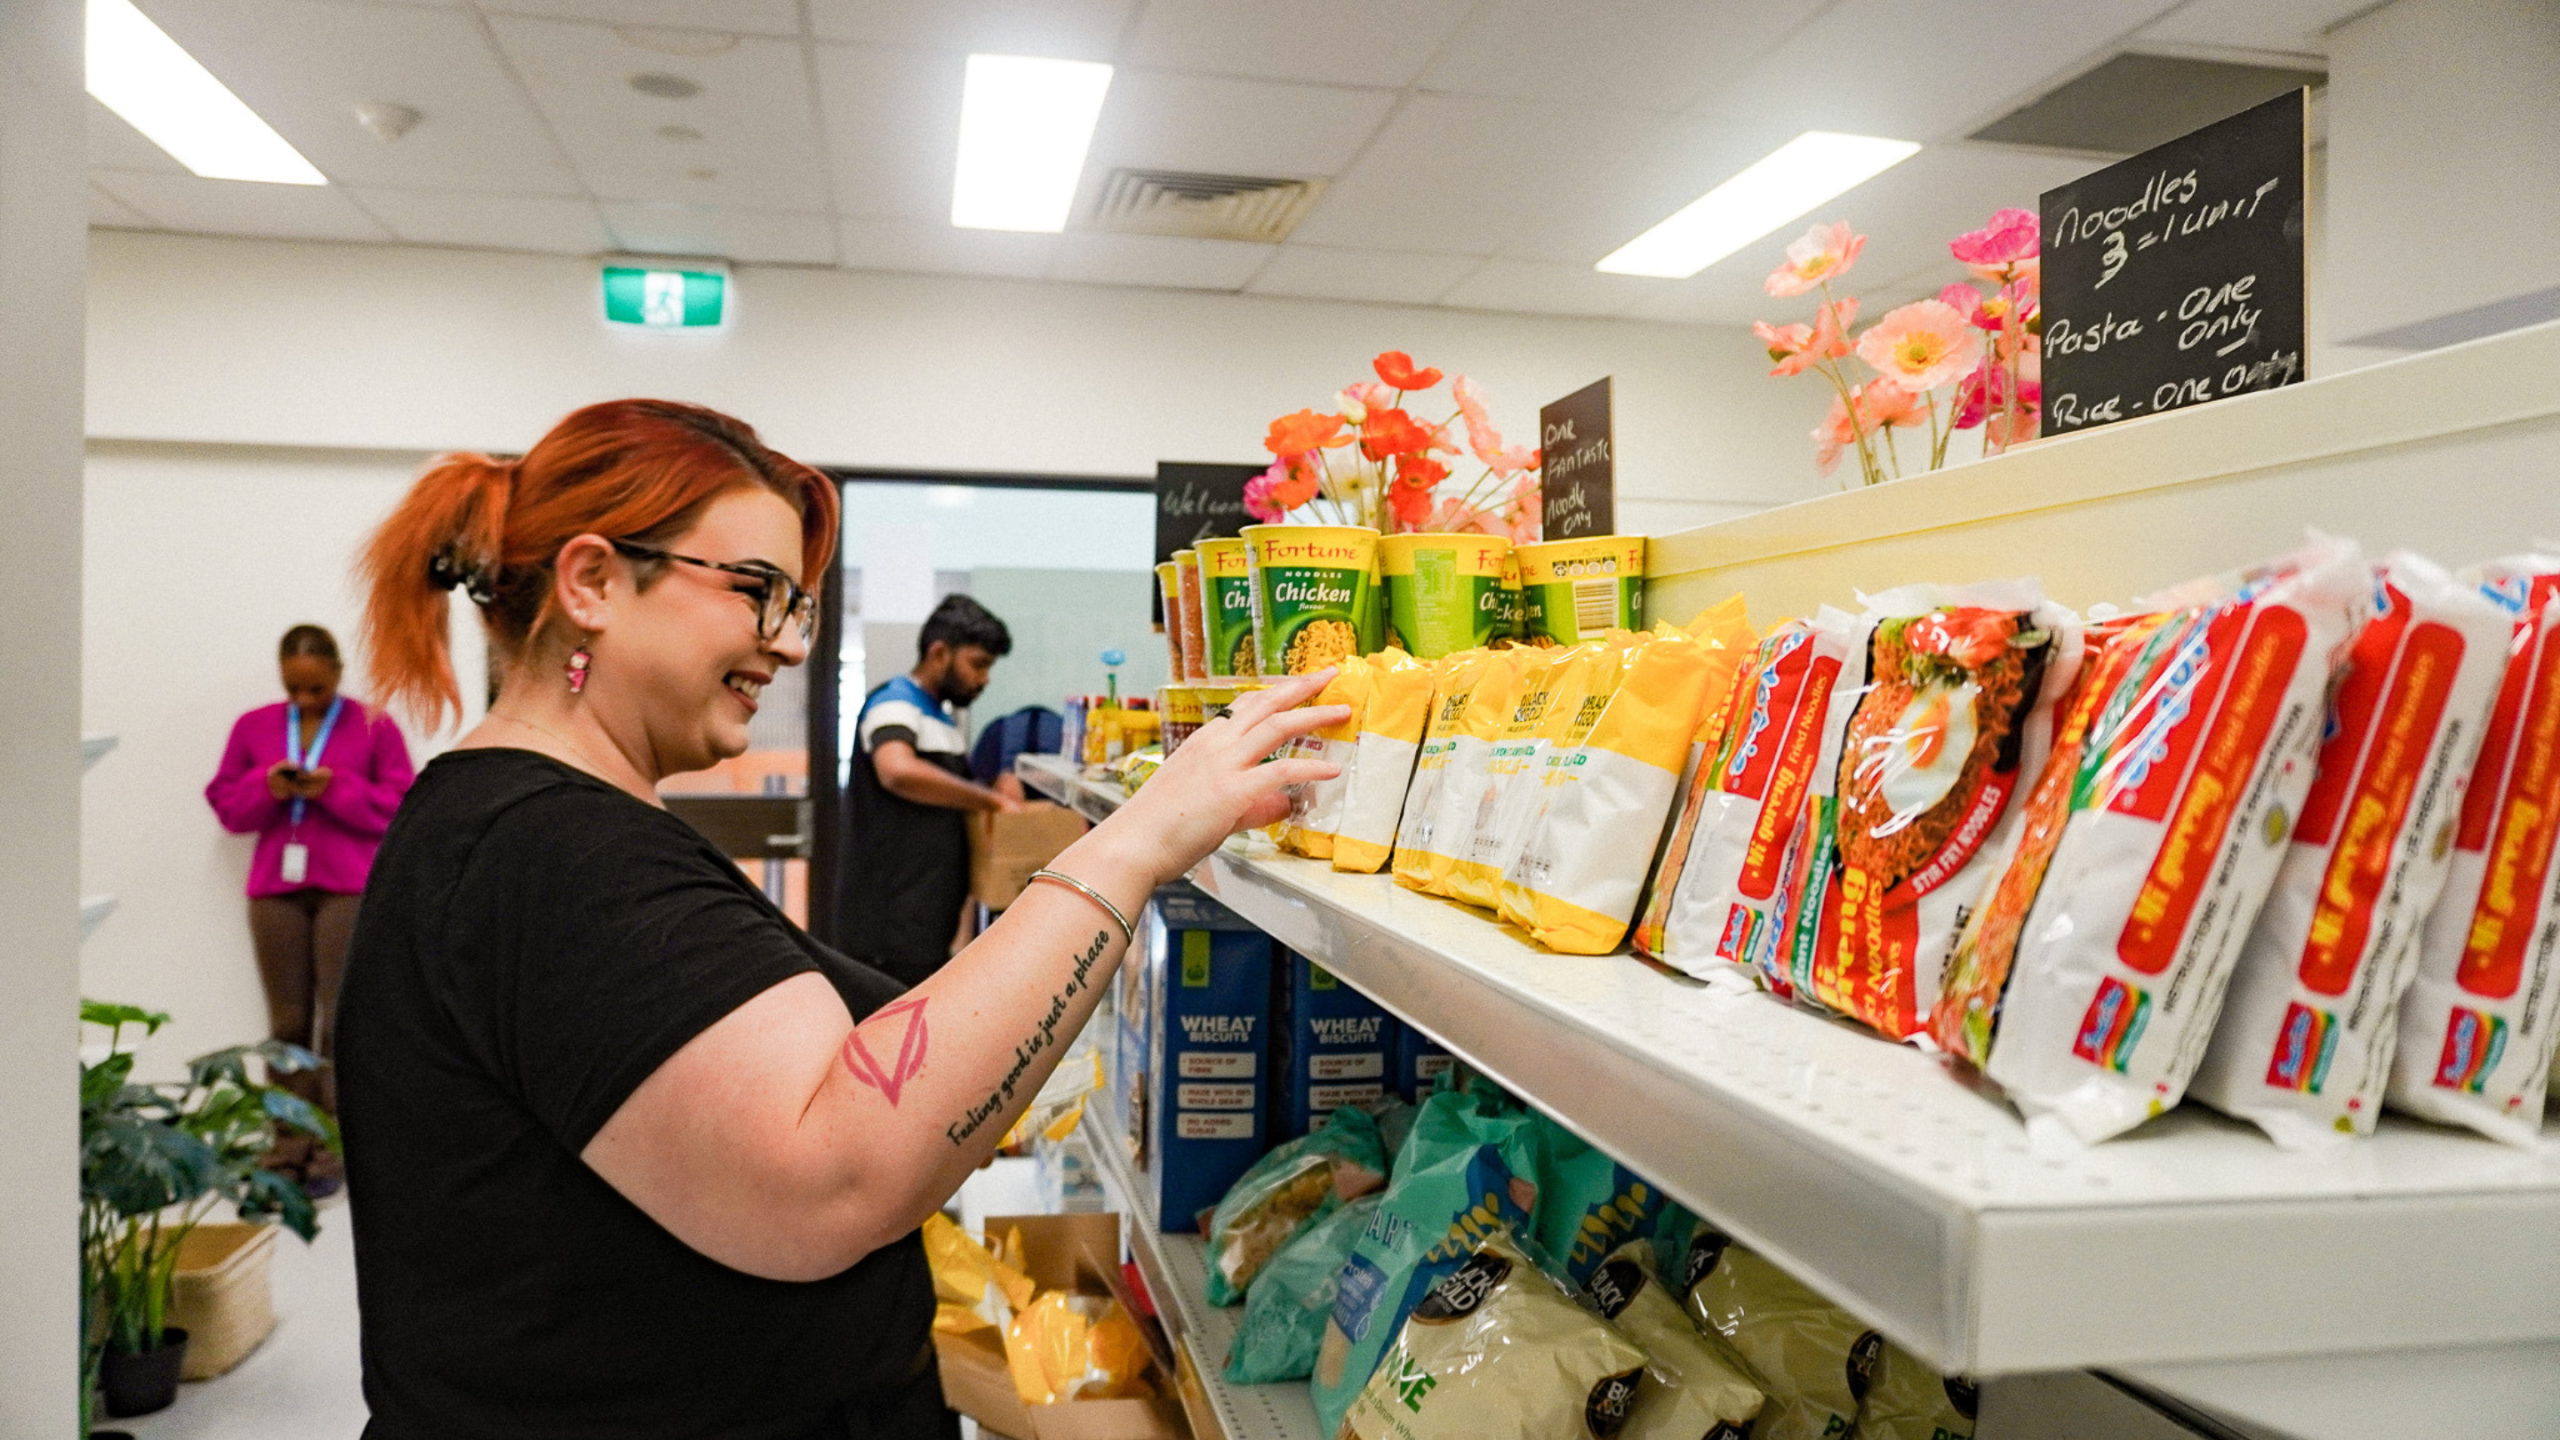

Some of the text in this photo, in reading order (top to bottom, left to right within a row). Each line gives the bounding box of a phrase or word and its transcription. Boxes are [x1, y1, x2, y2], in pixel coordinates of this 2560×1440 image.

[2045, 311, 2143, 359] Pasta
[2053, 393, 2122, 427] Rice
[1264, 539, 1360, 562] Fortune
[1285, 571, 1342, 579] NOODLES
[1275, 582, 1351, 603] Chicken
[1298, 603, 1326, 612] flavour
[1788, 729, 1807, 764] Fried
[1801, 675, 1828, 730] Noodles
[1911, 784, 2002, 894] STIR FRY NOODLES
[1801, 834, 1833, 928] Noodles
[1180, 1015, 1256, 1032] WHEAT
[1310, 1017, 1382, 1034] WHEAT
[946, 929, 1110, 1147] Feeling good is just a phase
[1189, 1031, 1250, 1043] BISCUITS
[1319, 1033, 1377, 1044] BISCUITS
[1591, 1268, 1626, 1314] BLACK
